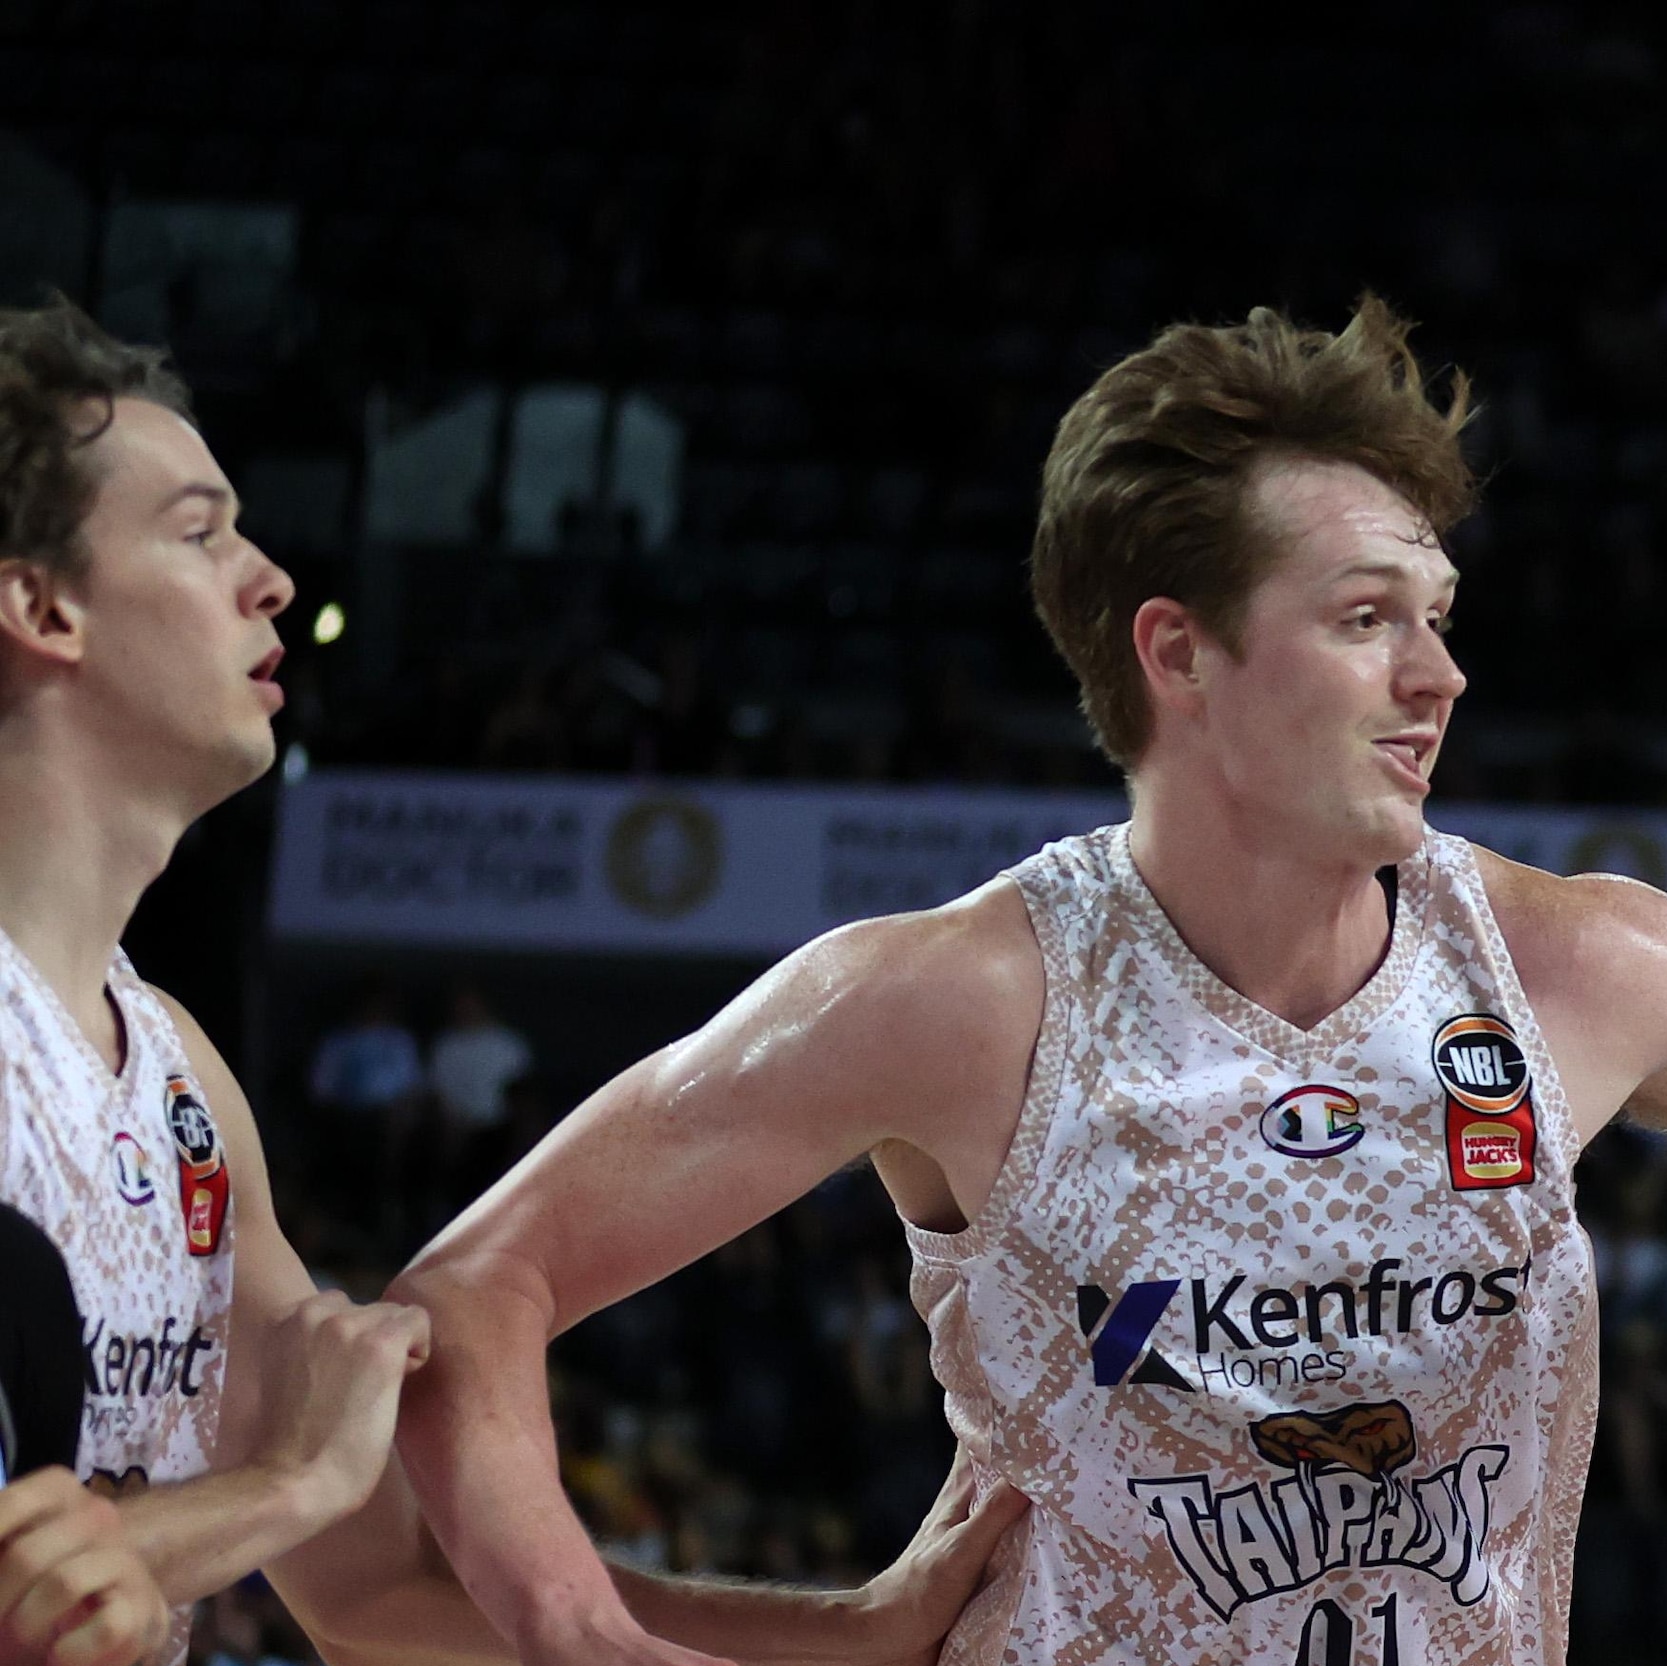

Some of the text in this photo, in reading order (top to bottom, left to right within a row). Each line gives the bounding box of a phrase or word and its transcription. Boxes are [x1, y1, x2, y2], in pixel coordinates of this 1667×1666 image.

[1449, 1044, 1513, 1087] NBL
[1197, 1350, 1348, 1393] Homes
[1127, 1444, 1511, 1625] TAIPANS
